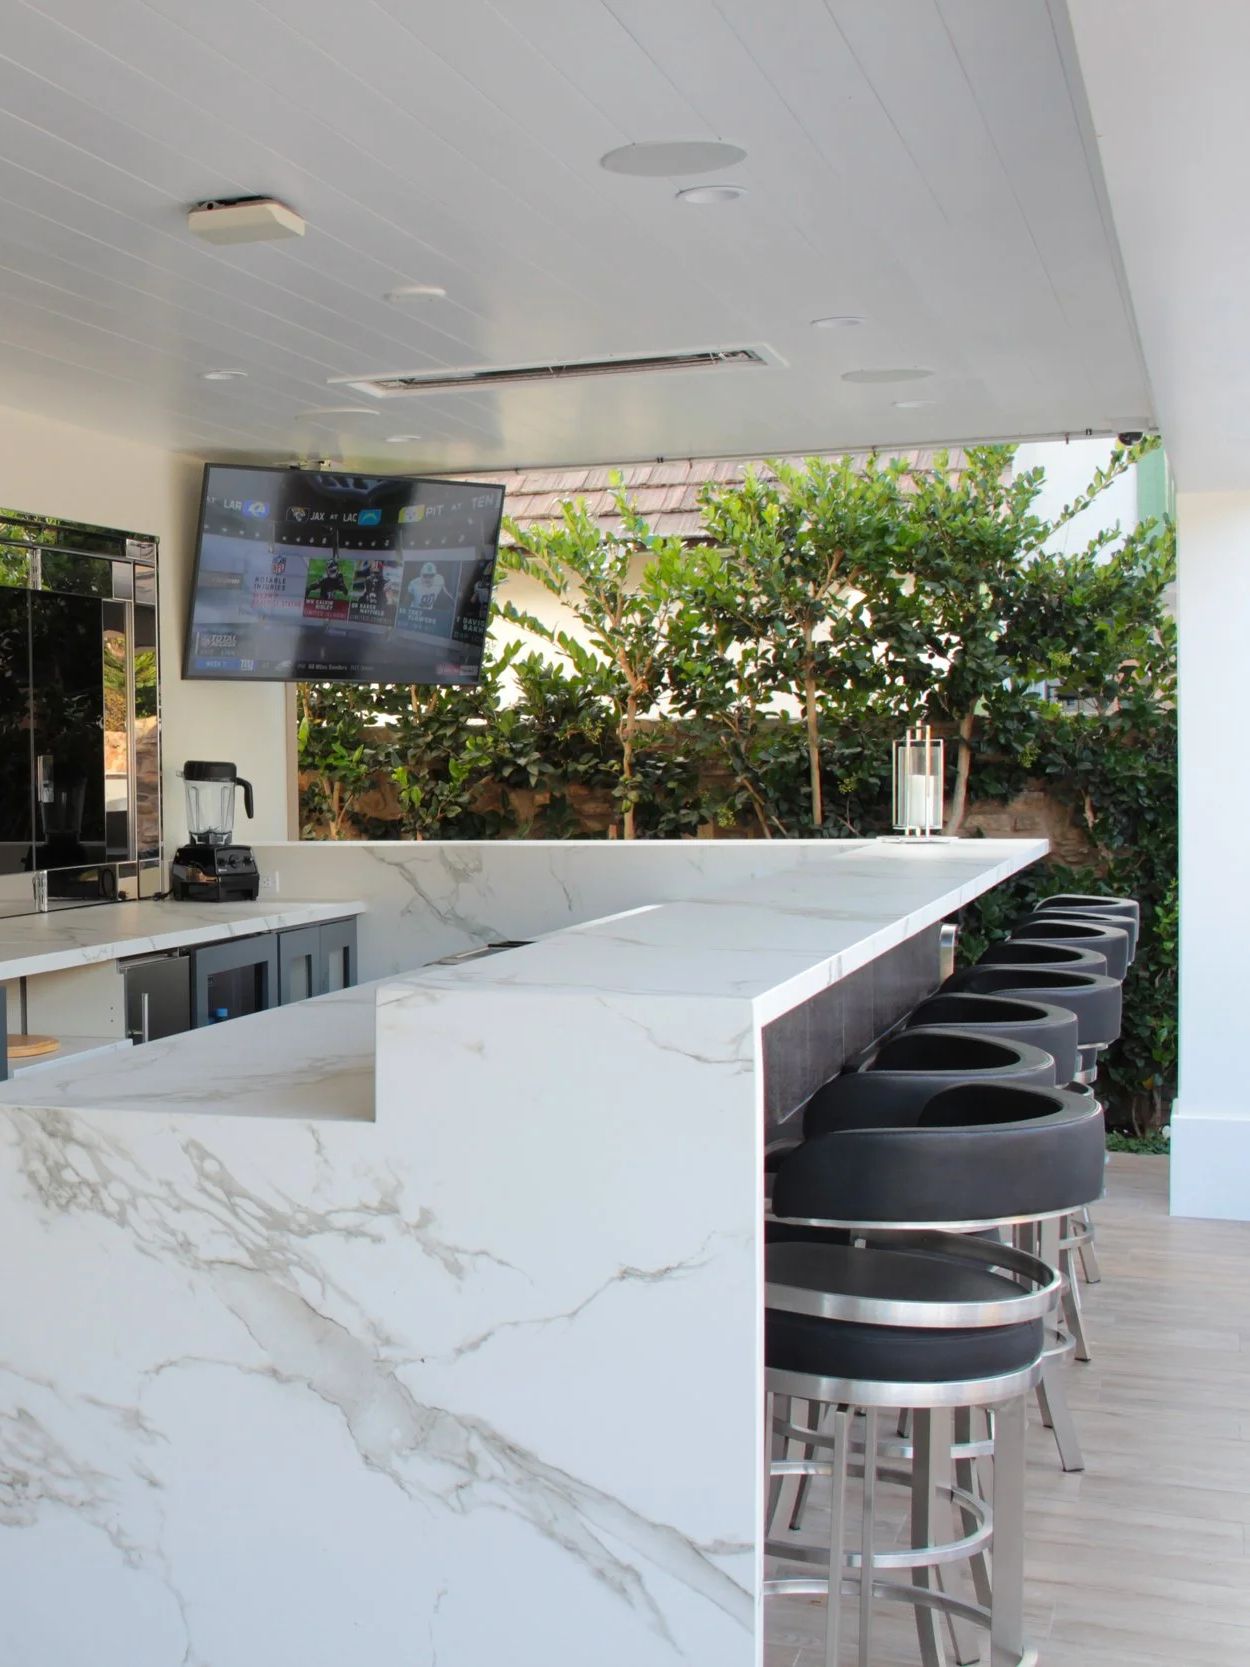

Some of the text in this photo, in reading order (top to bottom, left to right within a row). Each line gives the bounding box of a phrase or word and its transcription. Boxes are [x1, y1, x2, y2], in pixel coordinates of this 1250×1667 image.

[223, 499, 242, 511] LAR
[425, 505, 444, 518] PIT
[472, 495, 494, 510] TEN
[310, 512, 325, 521] JAX
[342, 513, 358, 523] LAC
[254, 576, 287, 585] NOTABLE
[253, 583, 286, 592] INJURIES
[359, 609, 385, 617] MAYFIELD
[407, 615, 437, 625] FLOWERS
[211, 634, 237, 642] TOTAL
